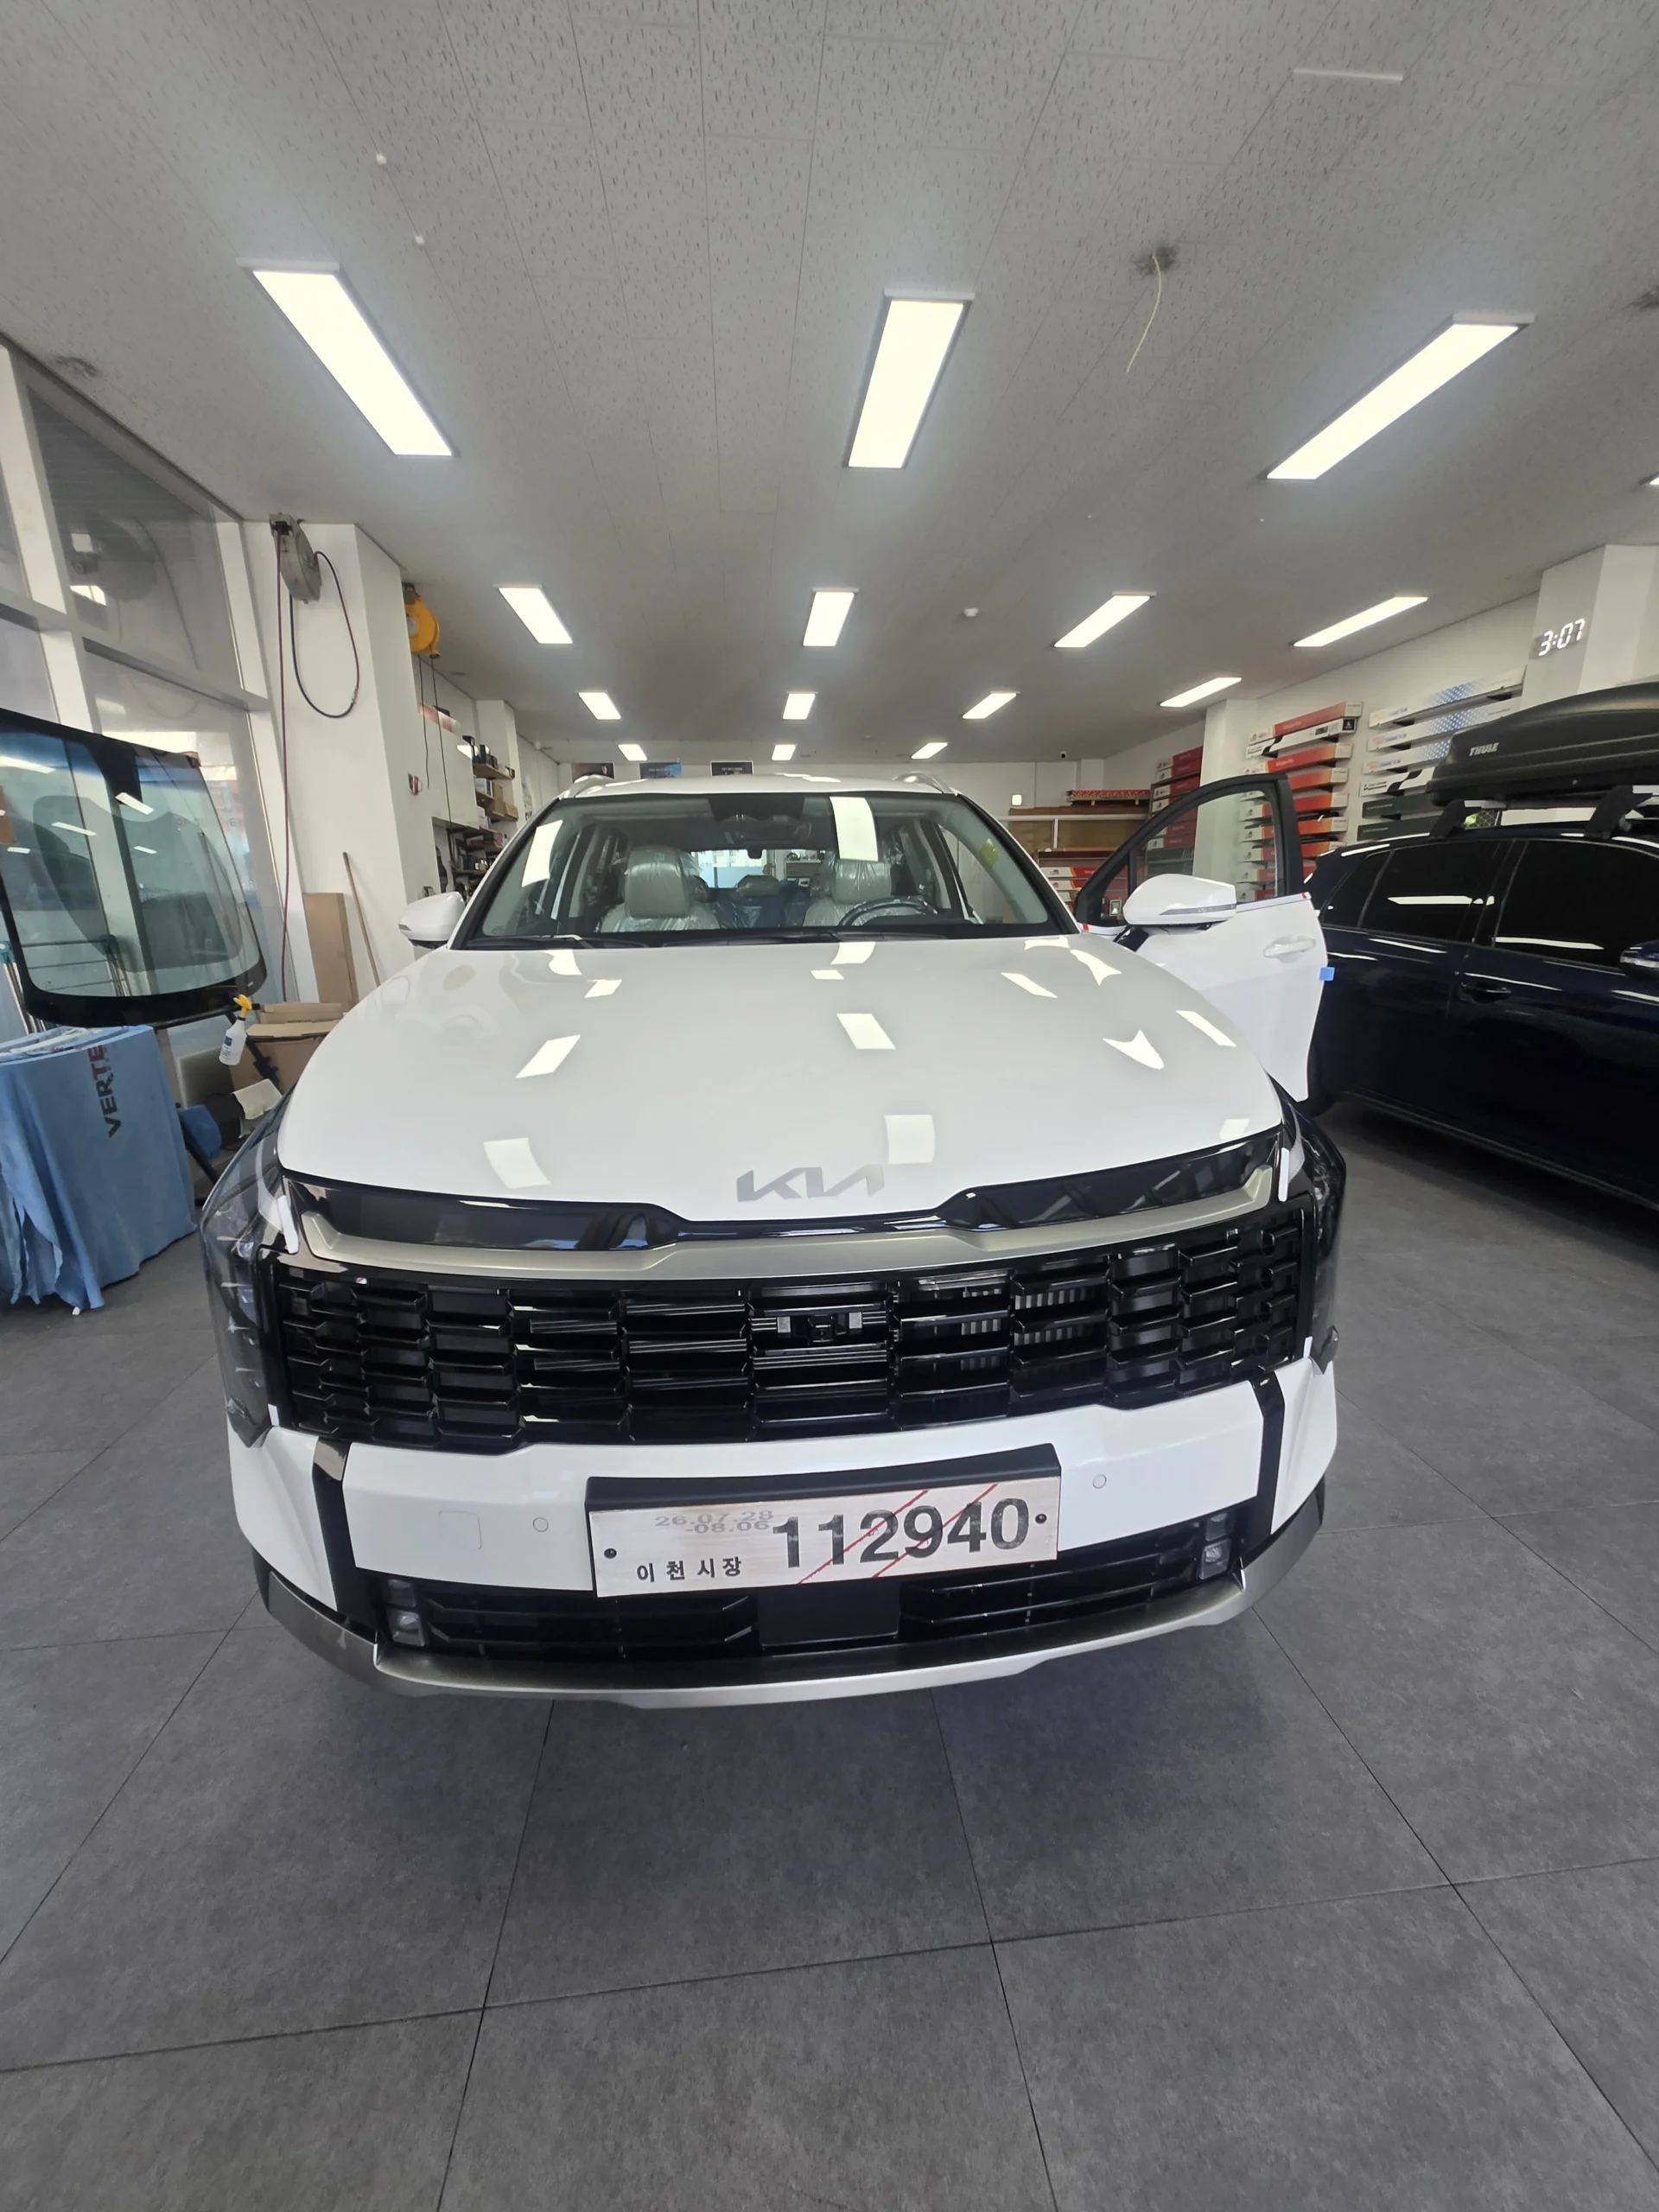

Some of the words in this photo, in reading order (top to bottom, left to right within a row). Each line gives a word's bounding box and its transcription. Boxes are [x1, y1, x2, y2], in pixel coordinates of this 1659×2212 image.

[1538, 618, 1586, 657] 3:07
[1471, 741, 1500, 757] THULE
[736, 1164, 884, 1202] KIA
[654, 1510, 774, 1527] 26.07.28
[772, 1497, 1029, 1569] 112940
